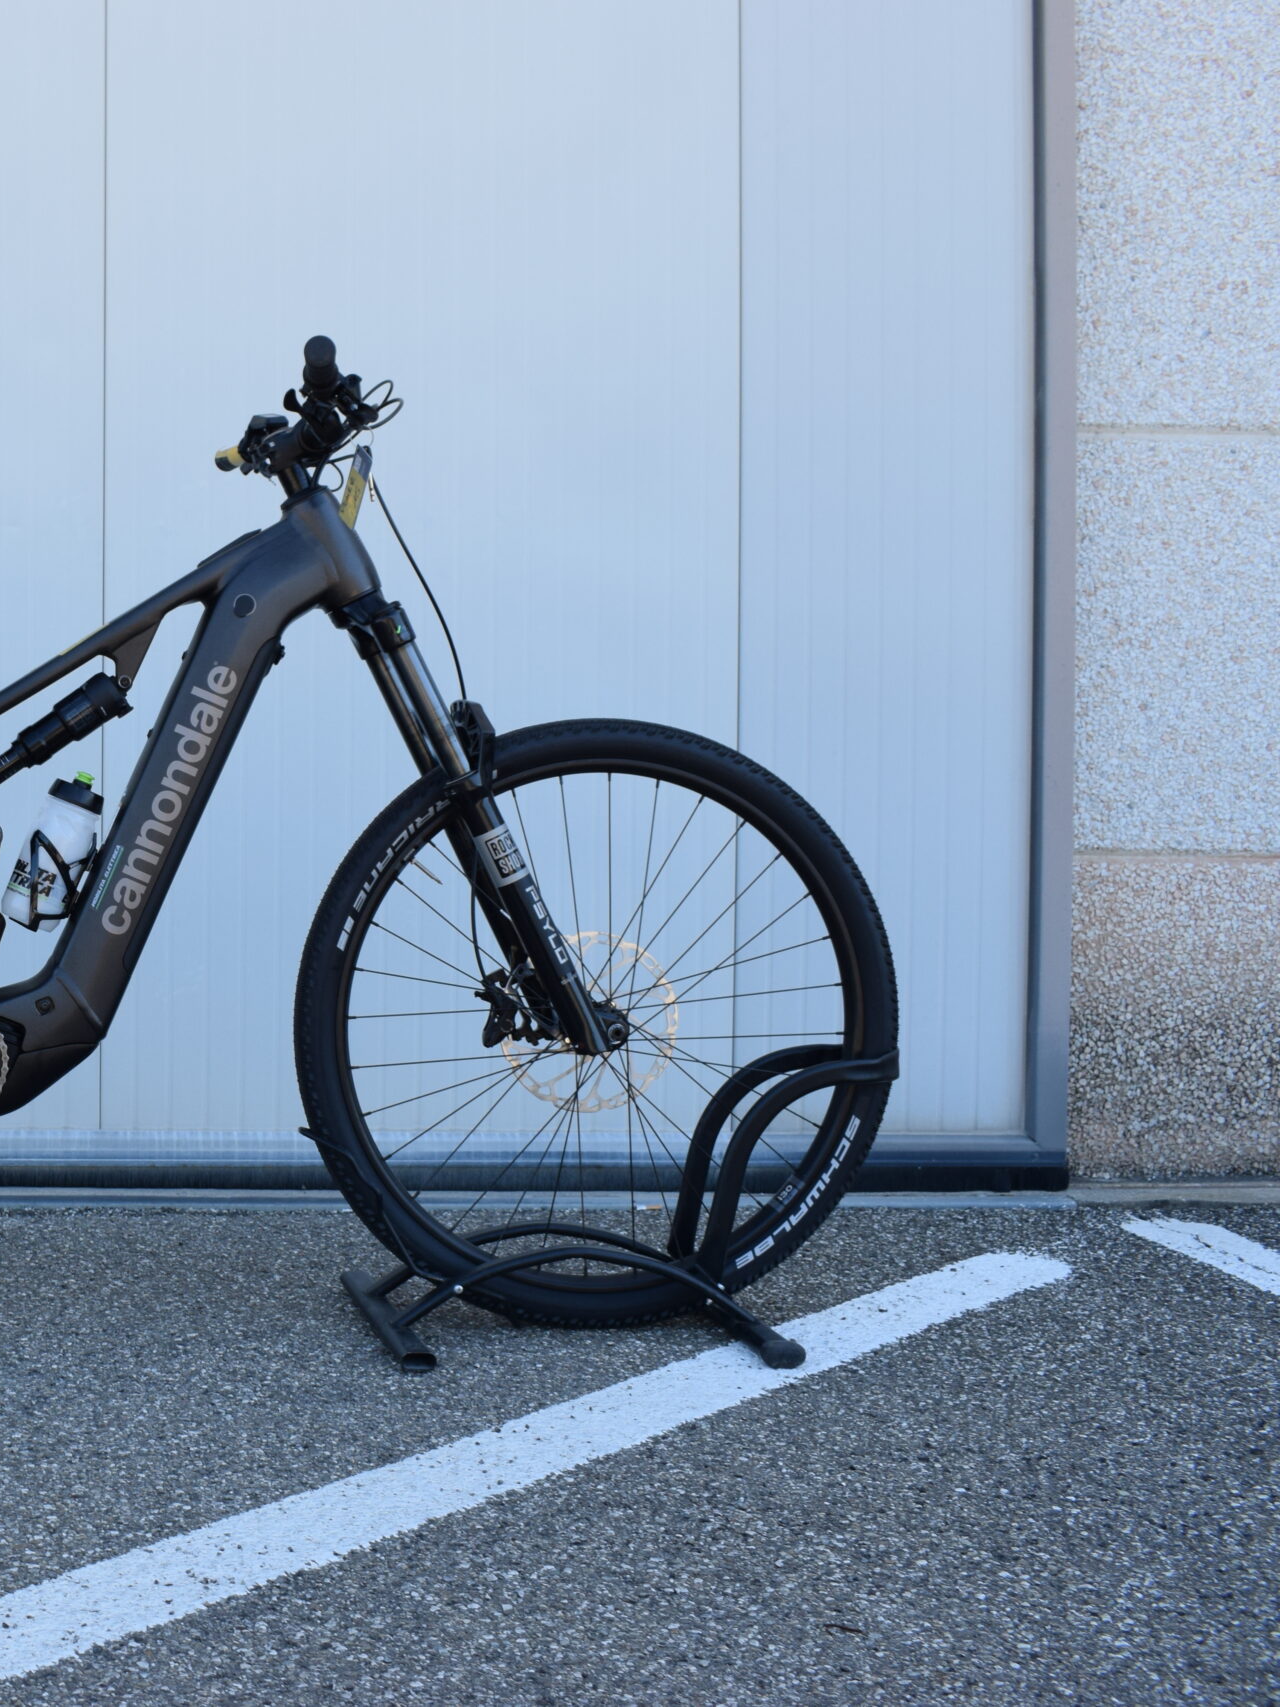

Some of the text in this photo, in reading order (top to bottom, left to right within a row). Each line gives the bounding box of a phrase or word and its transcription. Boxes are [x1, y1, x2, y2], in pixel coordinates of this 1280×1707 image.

[101, 665, 237, 935] cannondale
[525, 885, 569, 965] PSYLO
[735, 1114, 861, 1270] SCHWALBE
